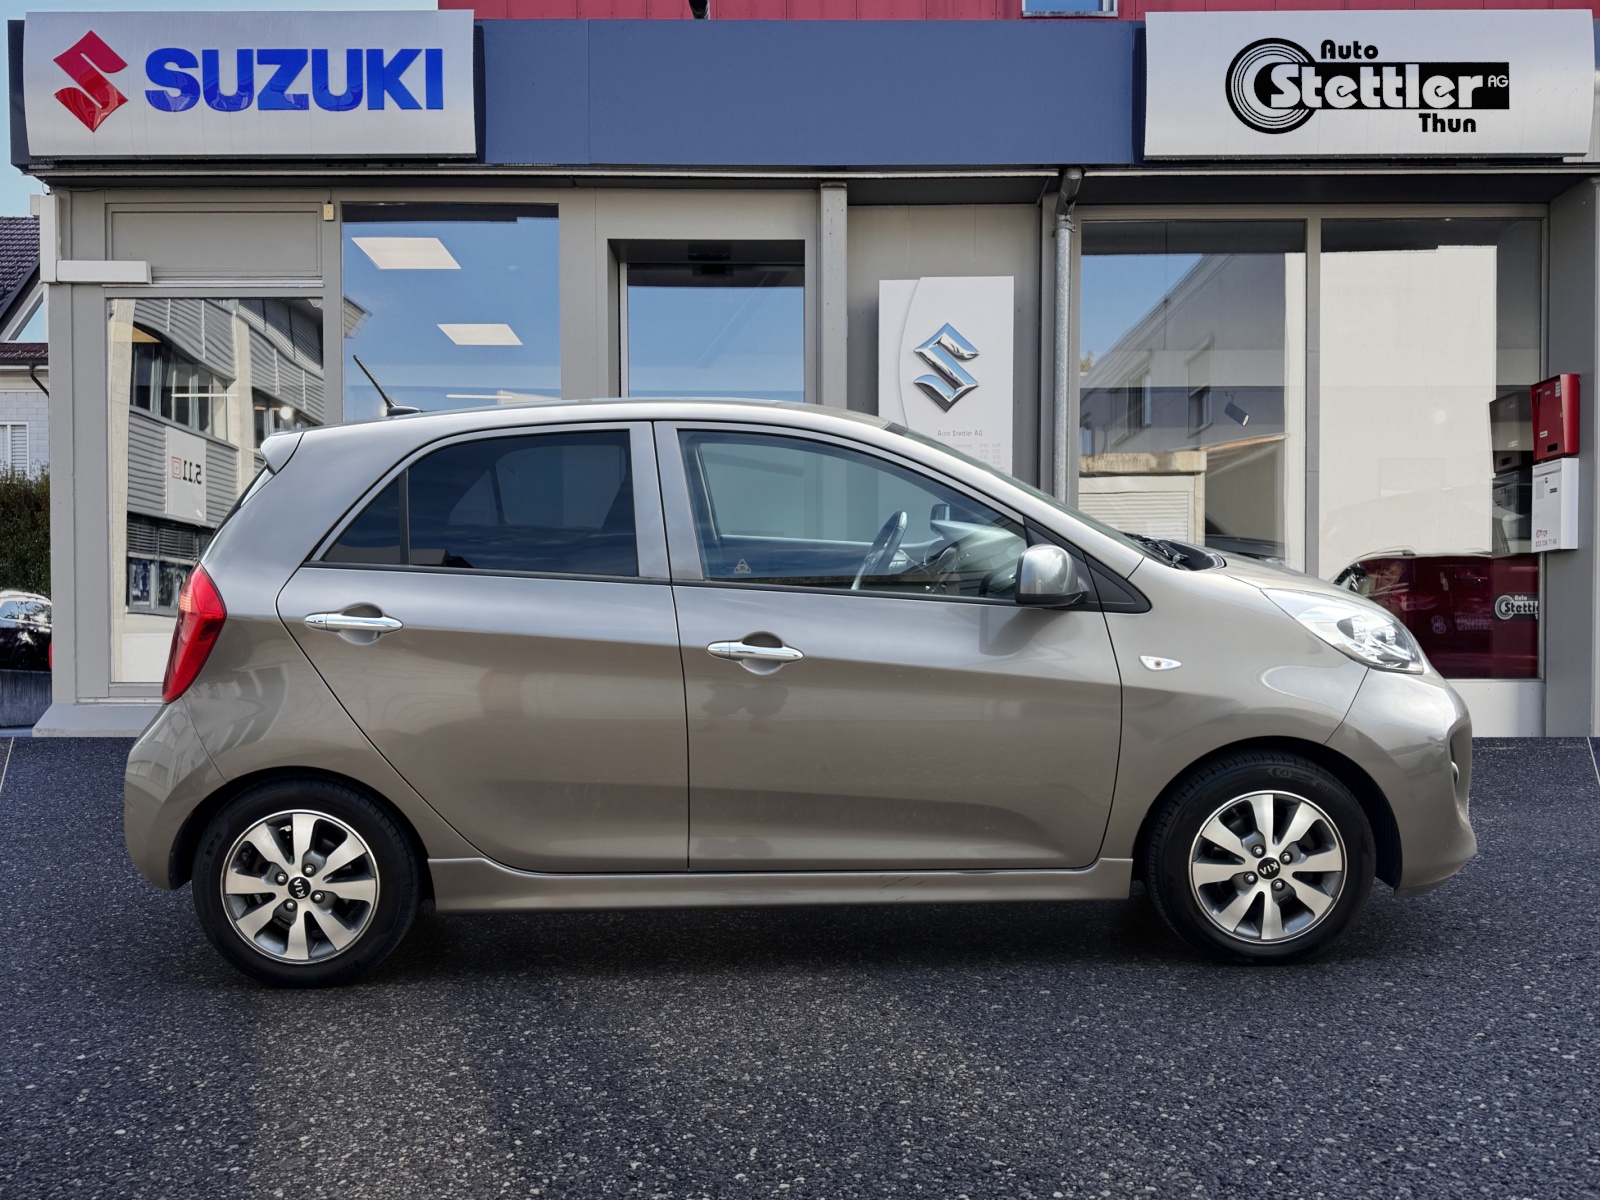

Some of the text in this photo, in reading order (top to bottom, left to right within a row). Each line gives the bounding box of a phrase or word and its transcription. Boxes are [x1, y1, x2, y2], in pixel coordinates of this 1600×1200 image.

[1320, 39, 1379, 60] Auto
[145, 47, 444, 112] SUZUKI
[1270, 63, 1509, 109] Stettler AG
[1418, 112, 1477, 133] Thun
[937, 429, 983, 437] Auto Stettler AG
[1259, 861, 1279, 875] KIA
[293, 878, 306, 898] KIA
